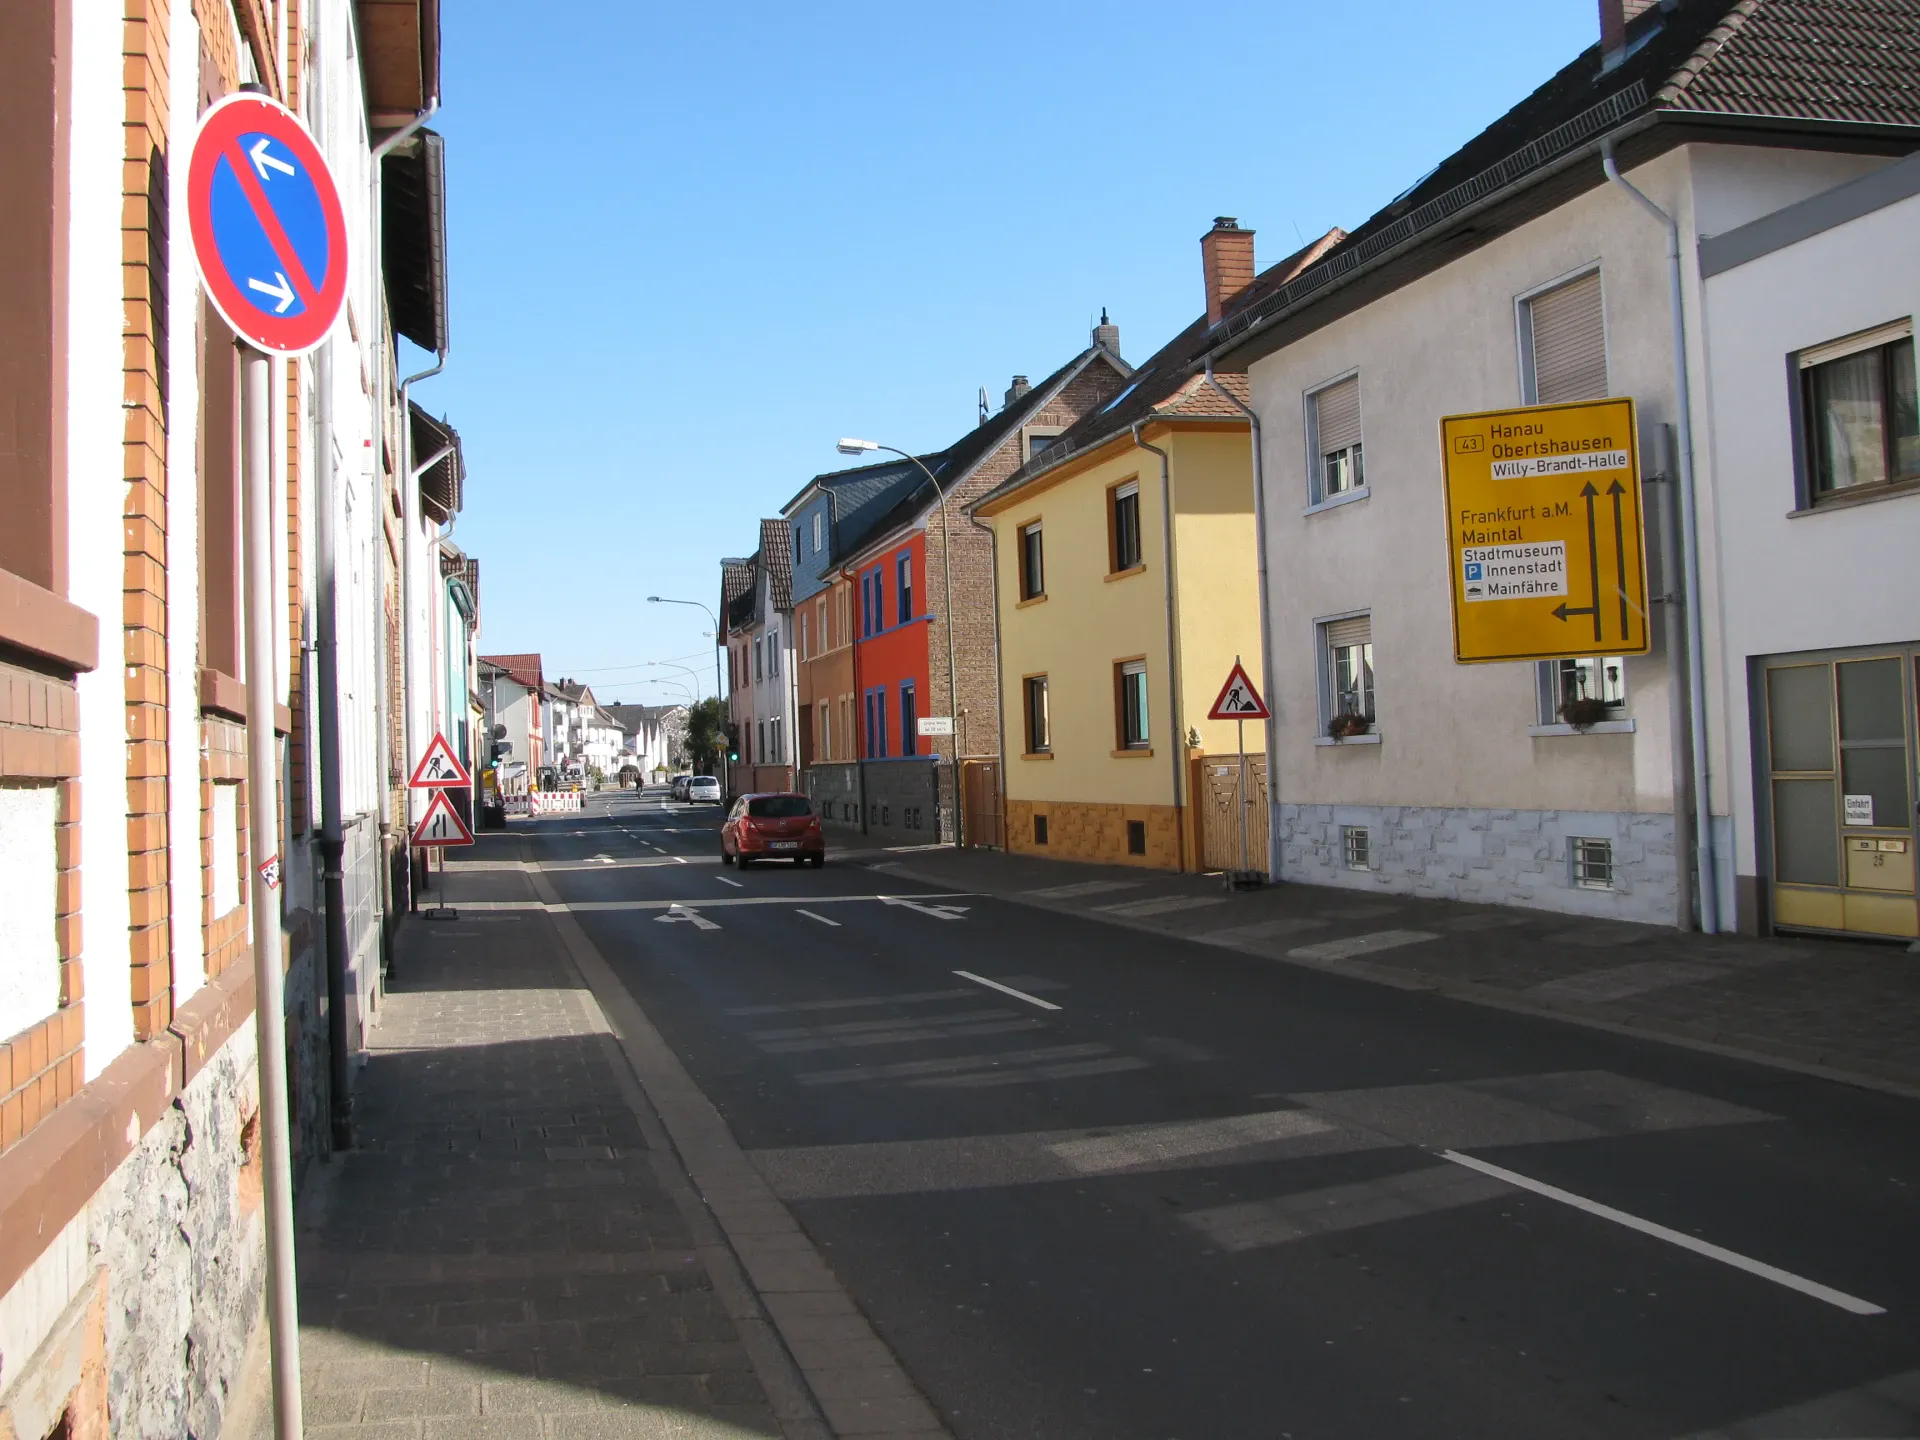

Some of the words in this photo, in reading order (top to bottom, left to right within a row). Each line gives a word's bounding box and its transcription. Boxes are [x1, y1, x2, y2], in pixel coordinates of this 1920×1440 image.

[1491, 423, 1544, 439] Hanau
[1462, 439, 1477, 450] 43
[1492, 436, 1612, 458] Obertshausen
[1493, 454, 1626, 477] Willy-Brandt-Halle
[1461, 505, 1536, 525] Frankfurt
[1542, 502, 1572, 518] a.M.
[1462, 527, 1523, 545] Maintal
[1464, 545, 1563, 562] Stadtmuseum
[1486, 561, 1562, 577] Innenstadt
[1488, 580, 1558, 596] Mainfähre
